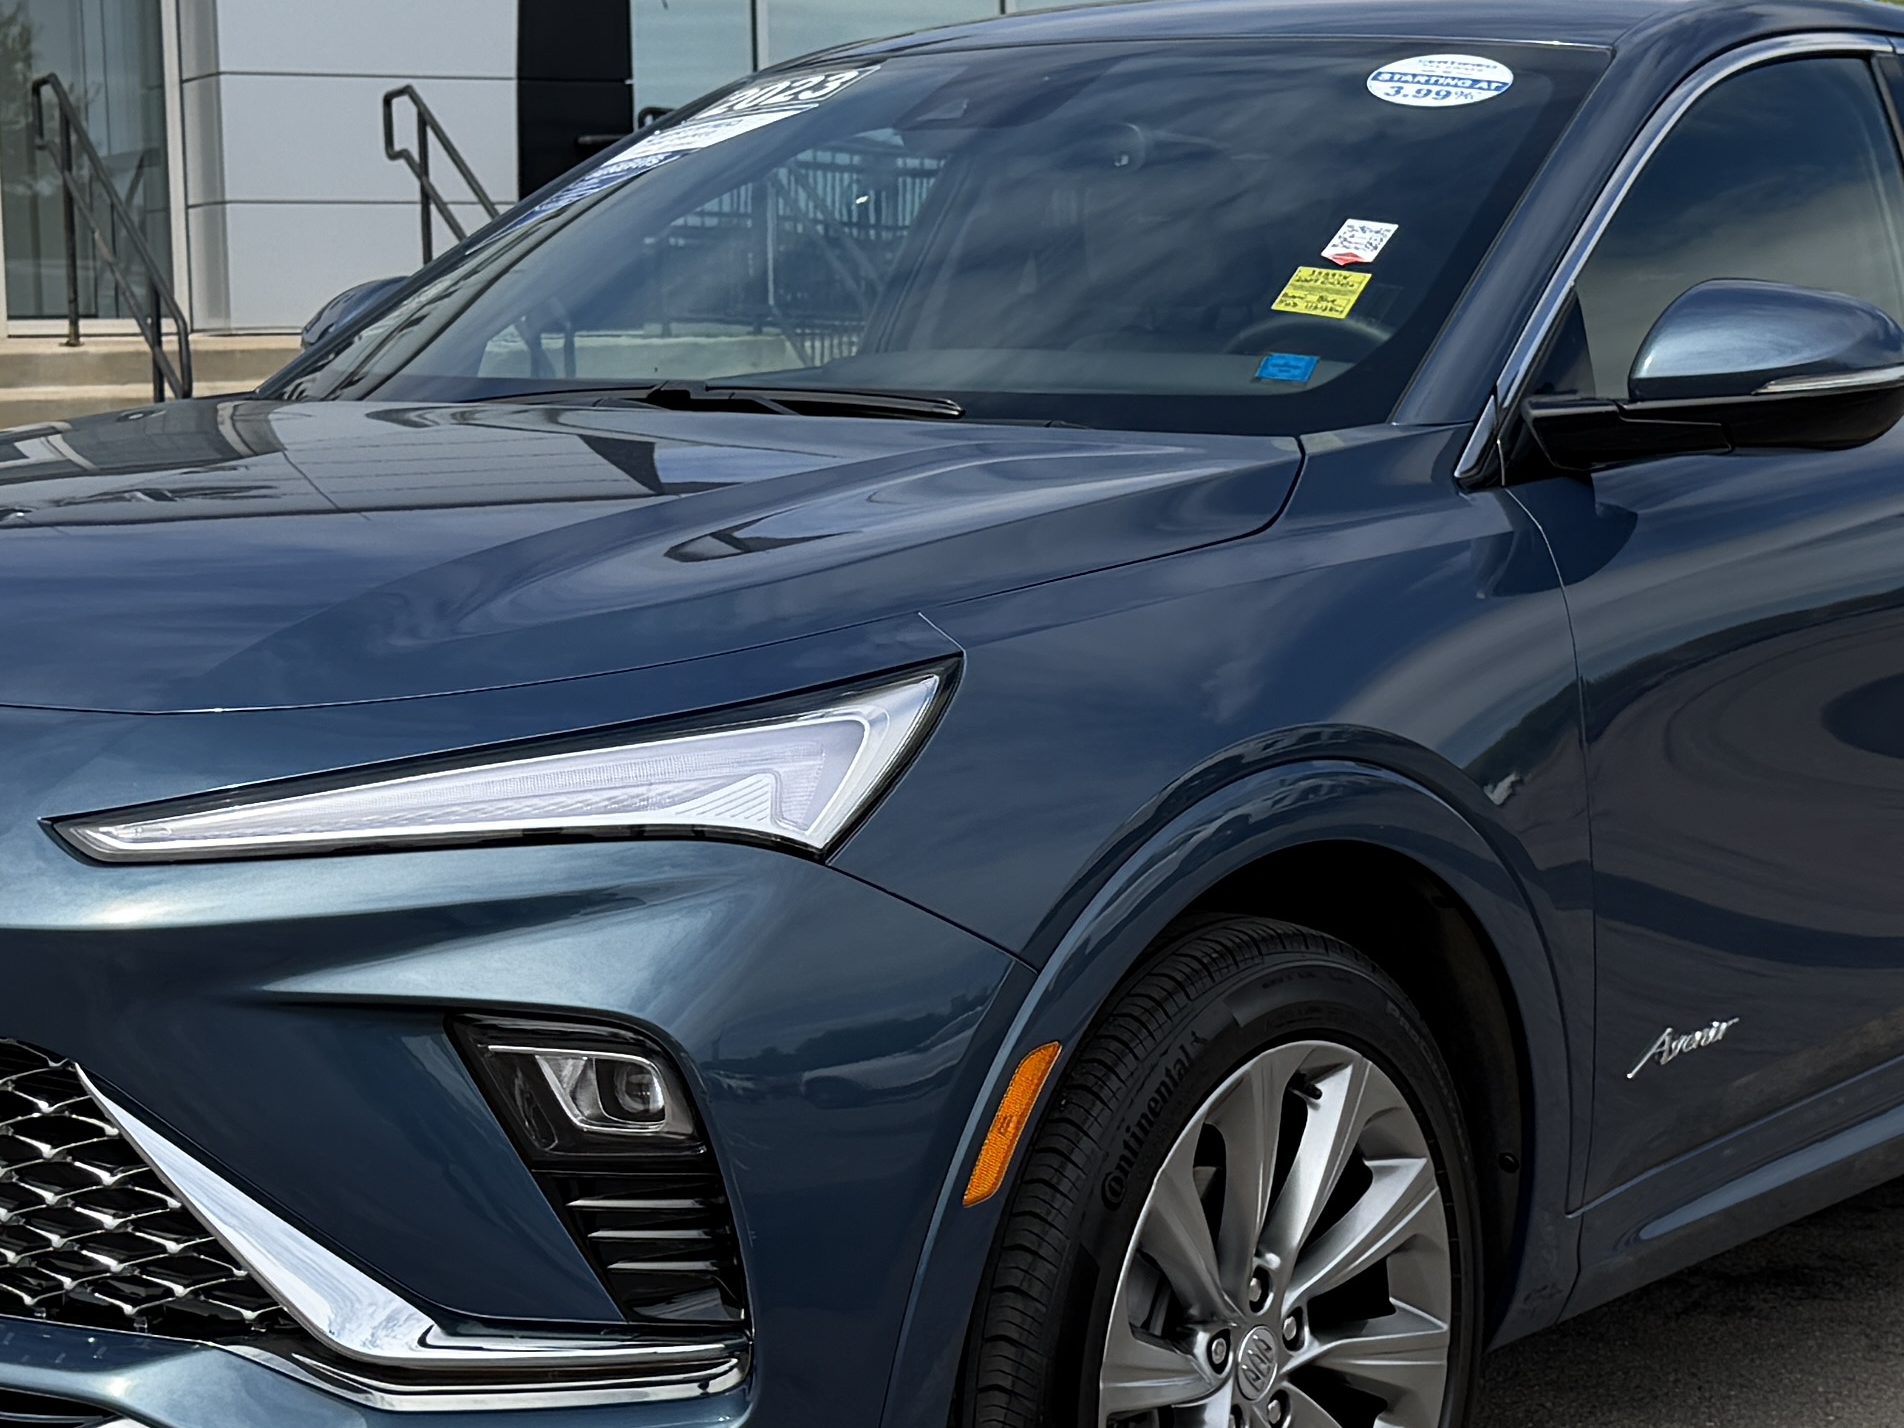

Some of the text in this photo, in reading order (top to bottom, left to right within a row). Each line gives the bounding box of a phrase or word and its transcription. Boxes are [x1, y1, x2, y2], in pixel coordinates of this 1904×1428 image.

[1378, 72, 1502, 91] STARTING AT
[1100, 1043, 1194, 1212] Continental
